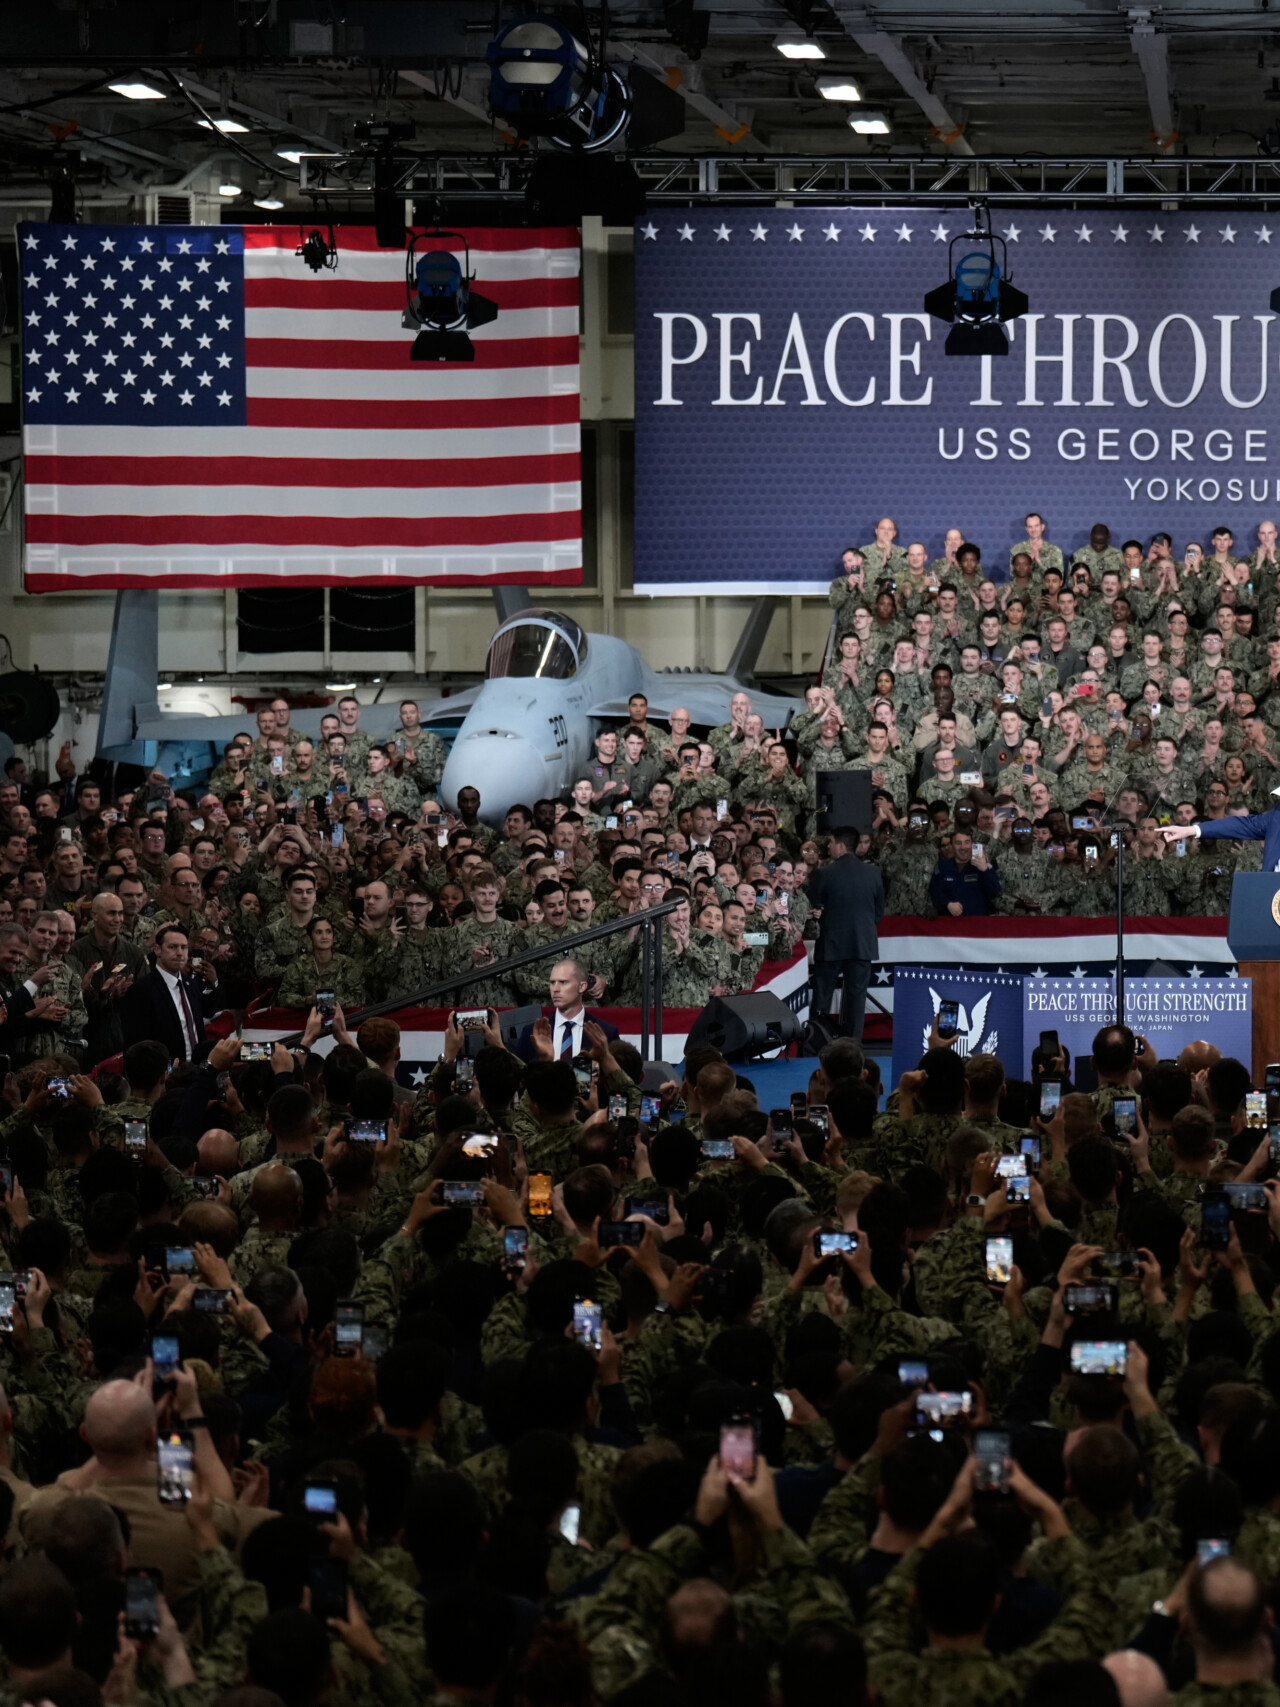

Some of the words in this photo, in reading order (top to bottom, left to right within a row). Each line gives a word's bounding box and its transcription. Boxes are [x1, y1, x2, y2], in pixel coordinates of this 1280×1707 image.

[653, 312, 933, 407] PEACE
[938, 427, 1032, 460] USS
[1057, 428, 1267, 462] GEORGE
[1027, 993, 1078, 1011] PEACE
[1163, 993, 1248, 1011] STRENGTH
[1064, 1014, 1085, 1022] USS
[1089, 1014, 1132, 1022] GEORE
[1137, 1014, 1210, 1022] WASHINGTON
